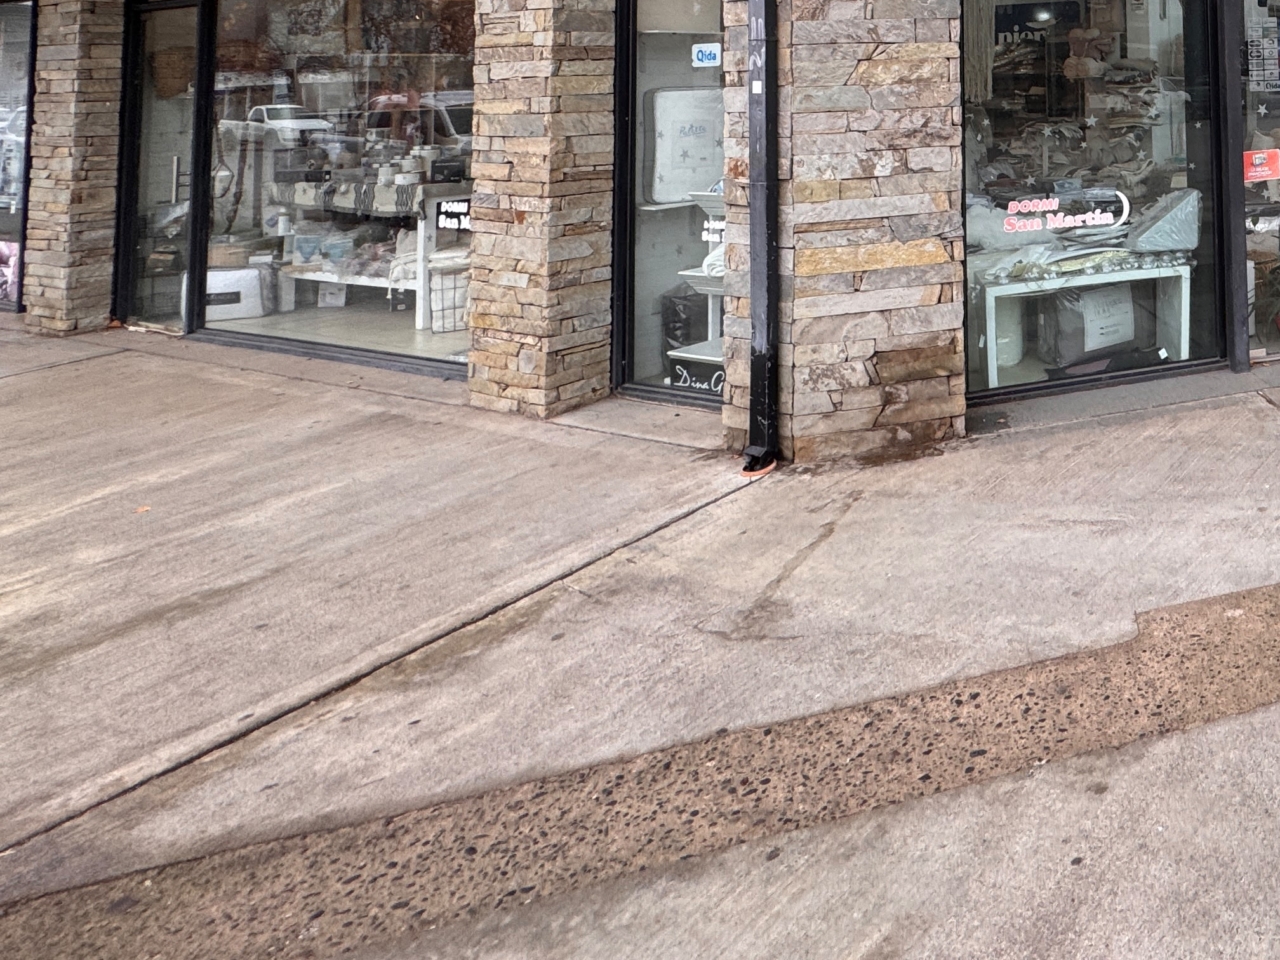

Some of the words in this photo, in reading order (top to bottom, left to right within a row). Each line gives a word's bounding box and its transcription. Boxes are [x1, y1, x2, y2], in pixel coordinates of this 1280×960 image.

[998, 24, 1046, 46] pier
[696, 49, 717, 63] Qida
[1008, 198, 1059, 214] DORMI
[1004, 217, 1042, 232] San
[674, 364, 709, 389] Dina
